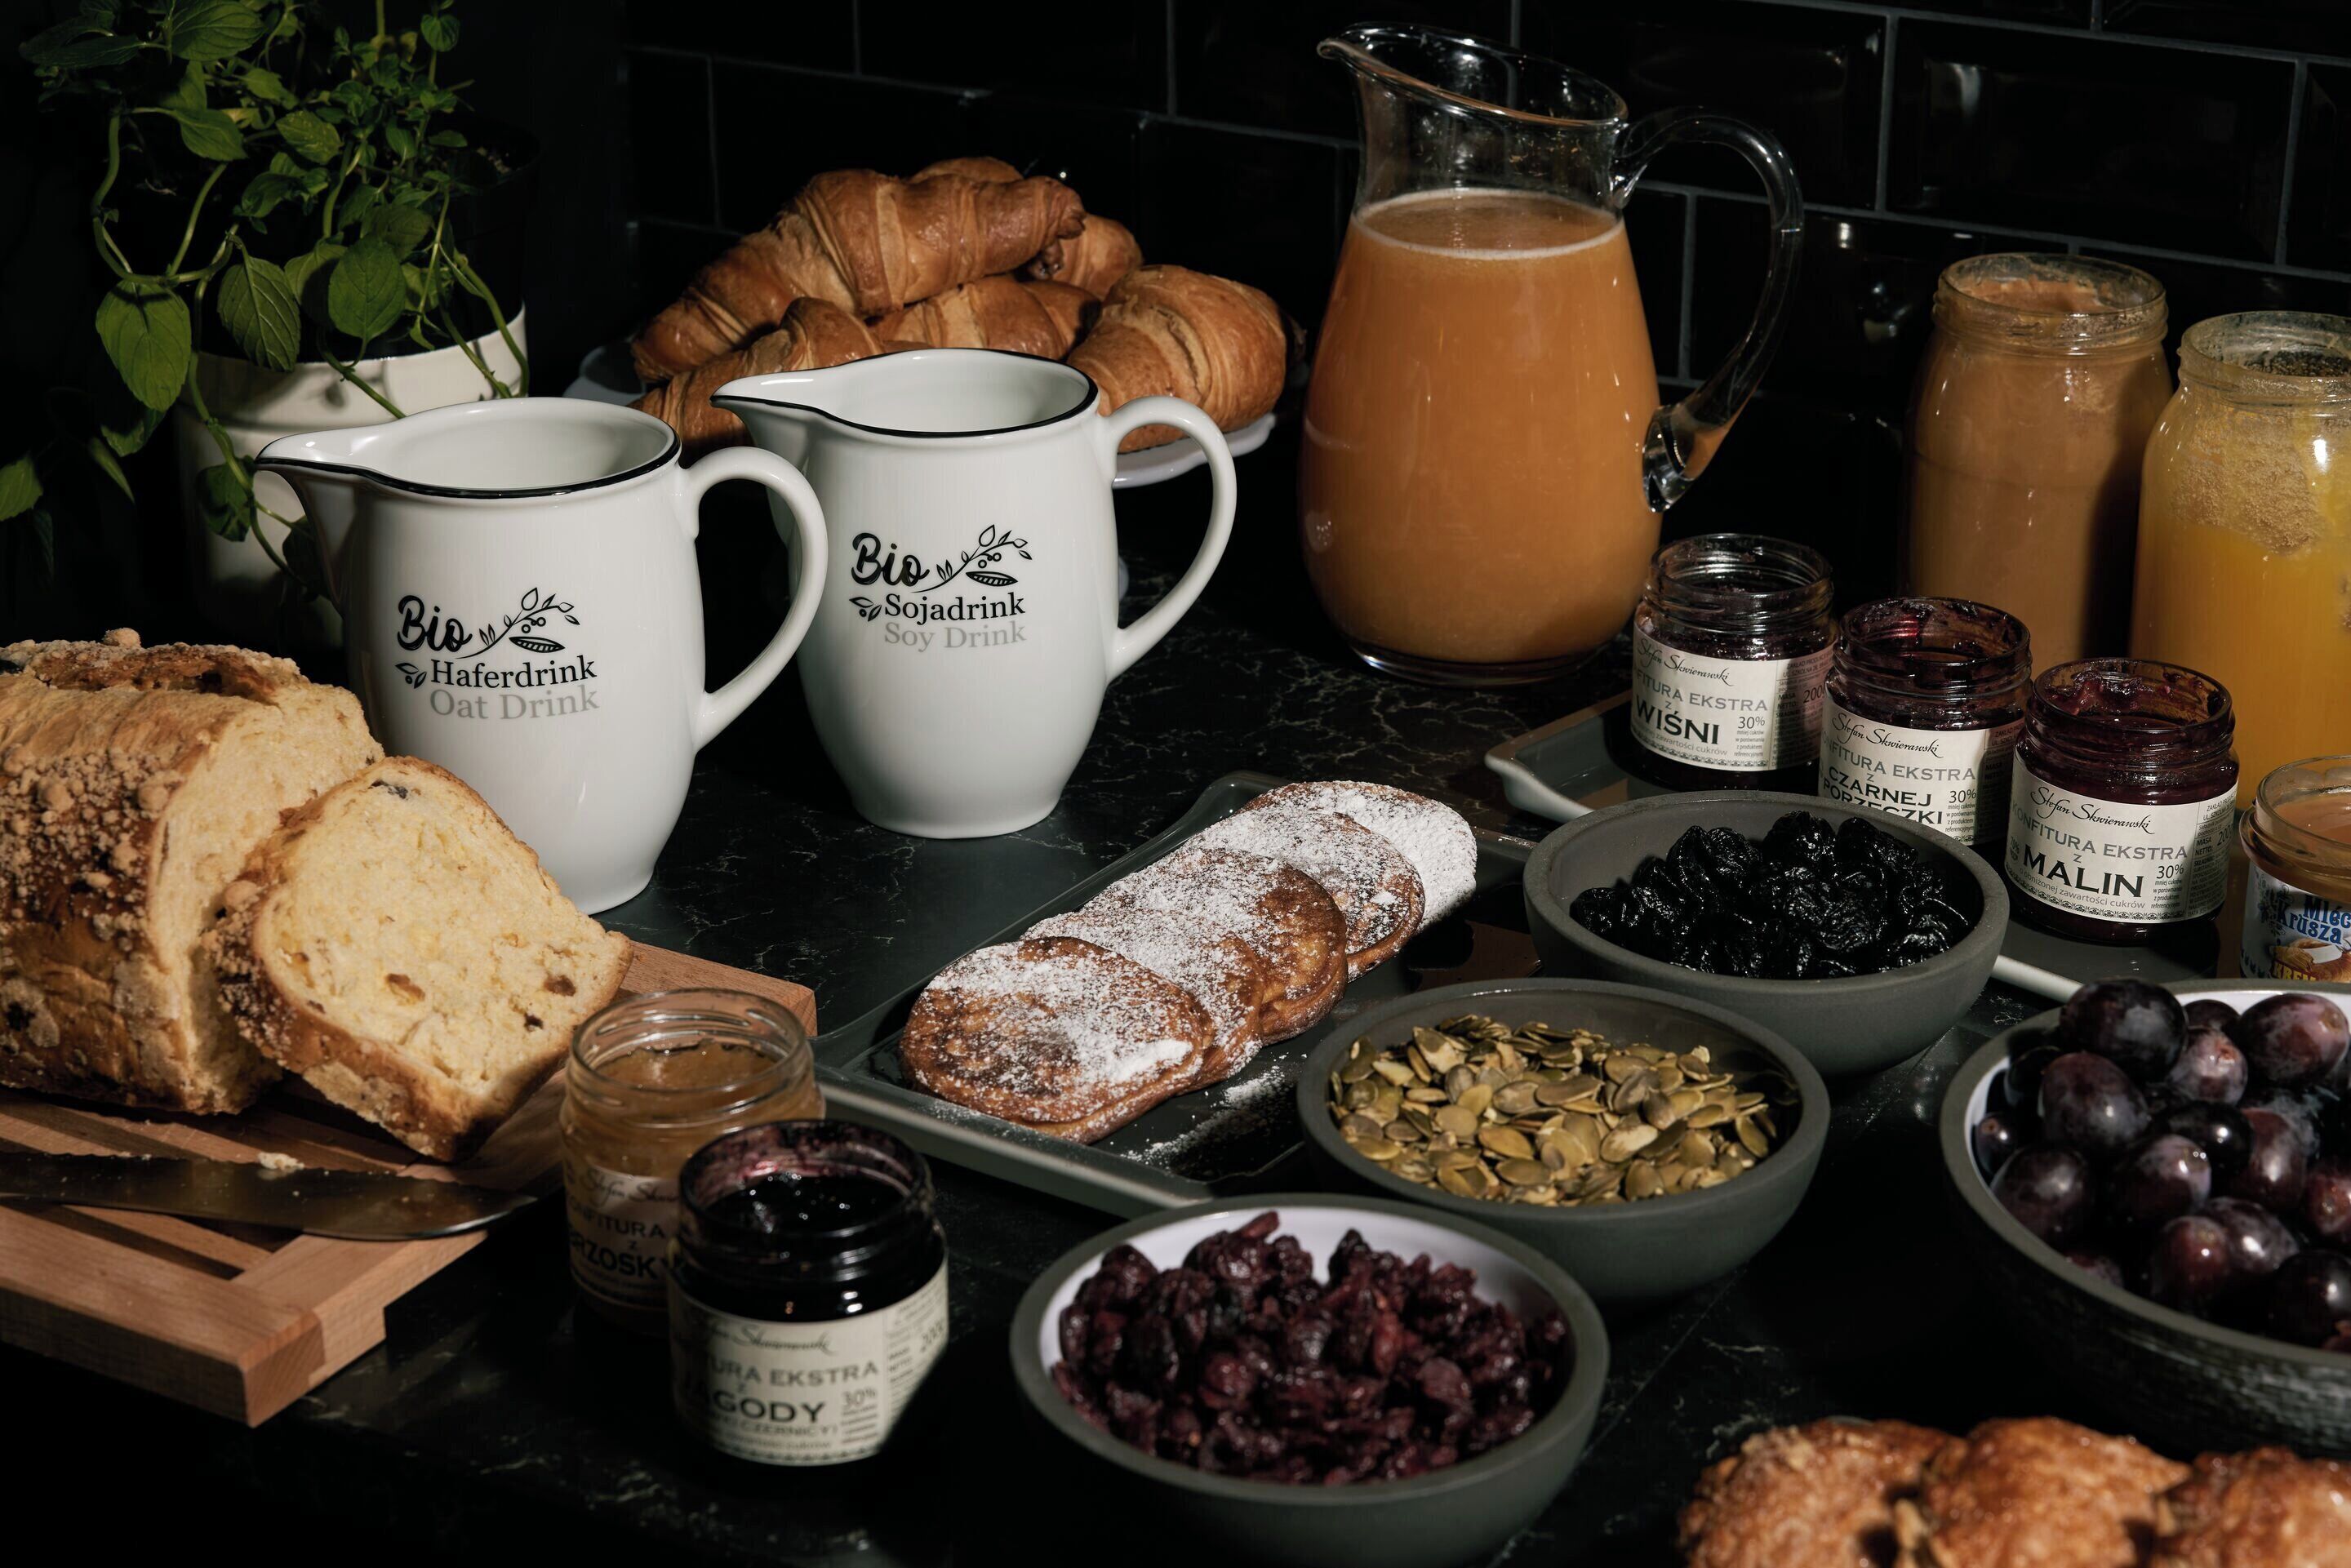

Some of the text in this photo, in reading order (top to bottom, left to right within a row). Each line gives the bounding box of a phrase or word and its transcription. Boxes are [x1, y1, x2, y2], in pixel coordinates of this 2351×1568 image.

[851, 532, 931, 587] Bio
[397, 594, 473, 653] Bio
[885, 592, 1026, 625] Sojadrink
[885, 620, 1028, 653] Soy Drink
[430, 655, 598, 689] Haferdrink
[429, 684, 601, 720] Oat Drink
[1688, 692, 1769, 713] EKSTRA
[1635, 694, 1721, 745] WIŚNI
[1737, 715, 1766, 730] 30%
[1832, 713, 1864, 744] Stefan
[1865, 727, 1944, 759] Skwierawski
[1829, 766, 1932, 807] CZARNEJ
[1892, 764, 1976, 781] EKSTRA
[1949, 788, 1977, 803] 30%
[2030, 786, 2071, 820] Stefan
[2072, 803, 2156, 835] Skwierawski
[2103, 846, 2189, 861] EKSTRA
[2023, 843, 2144, 899] MALIN
[2156, 863, 2184, 879] 30%
[2059, 887, 2109, 907] zawartości
[2109, 899, 2146, 909] cukrów
[769, 1361, 879, 1388] EKSTRA
